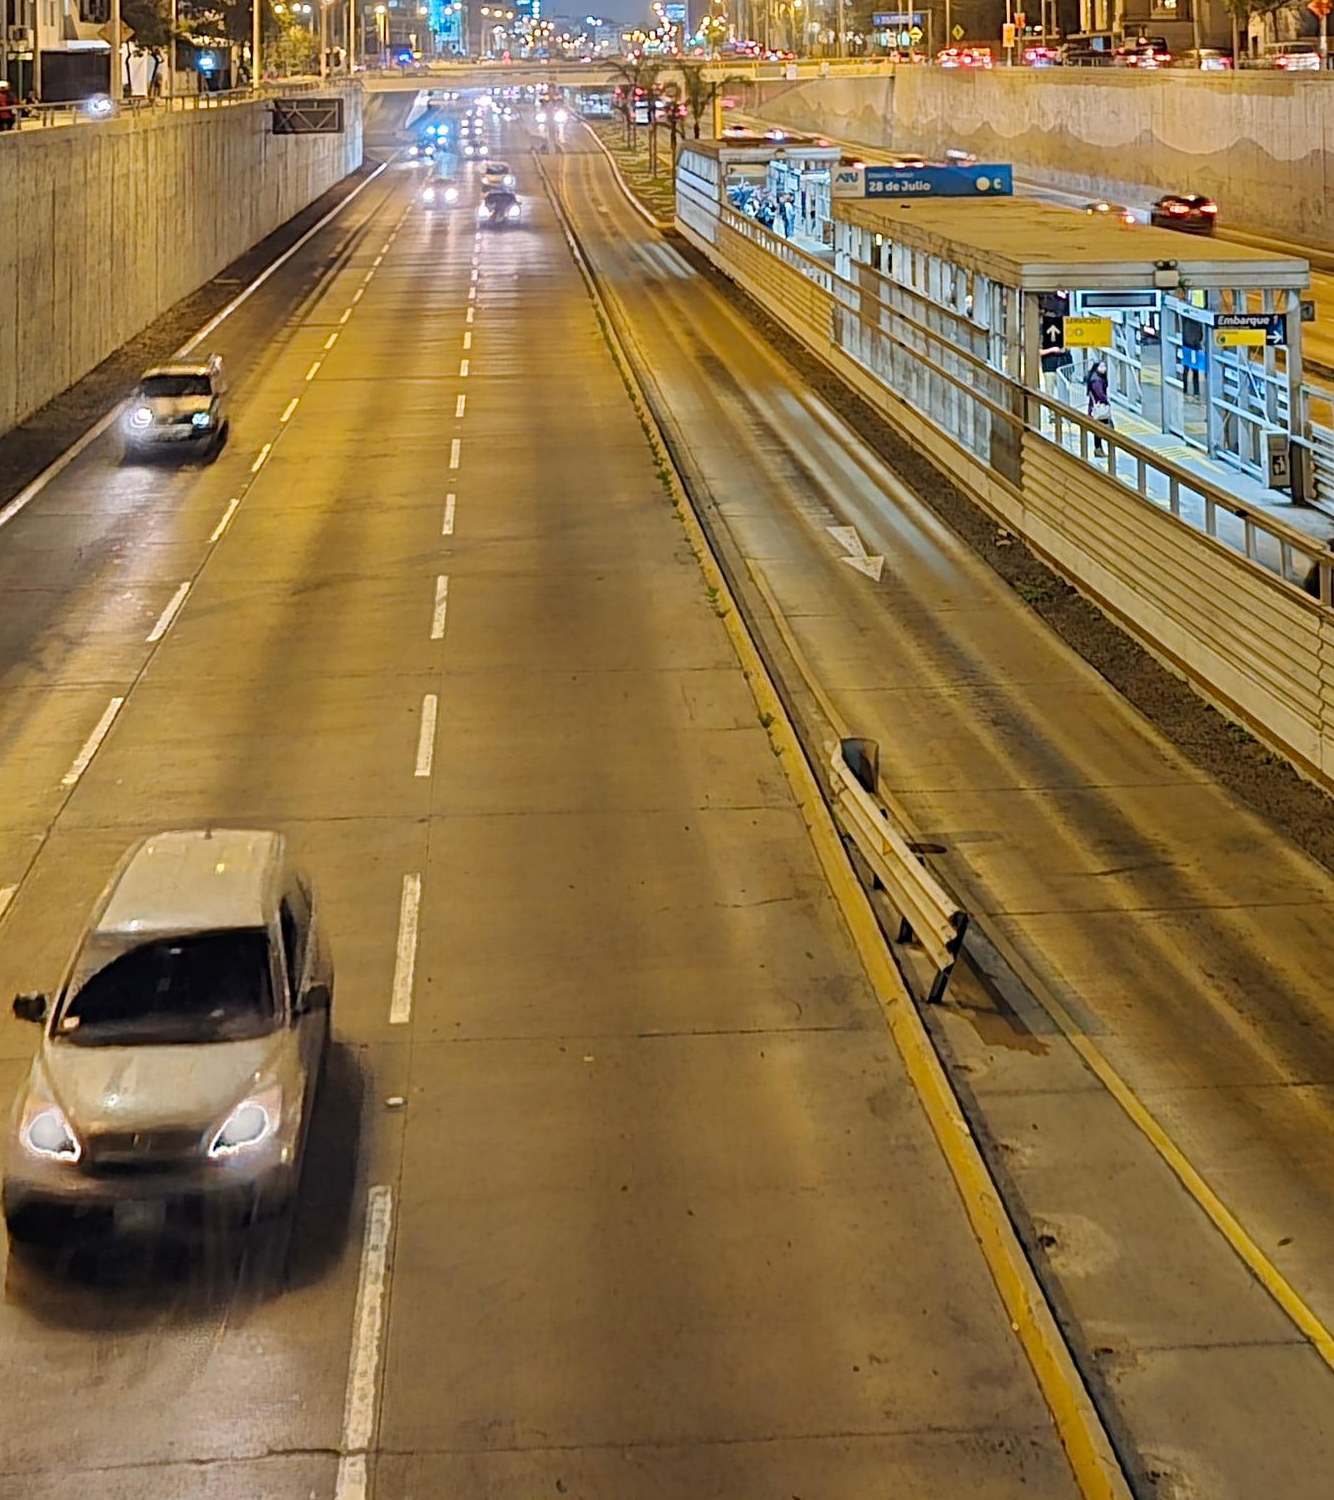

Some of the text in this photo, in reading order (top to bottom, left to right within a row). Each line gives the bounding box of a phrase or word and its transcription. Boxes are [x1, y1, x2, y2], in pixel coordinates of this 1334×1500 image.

[835, 172, 859, 183] ATU
[869, 181, 883, 192] 28
[885, 182, 900, 192] de
[901, 181, 931, 192] Julio
[1217, 315, 1279, 327] Embarque 1
